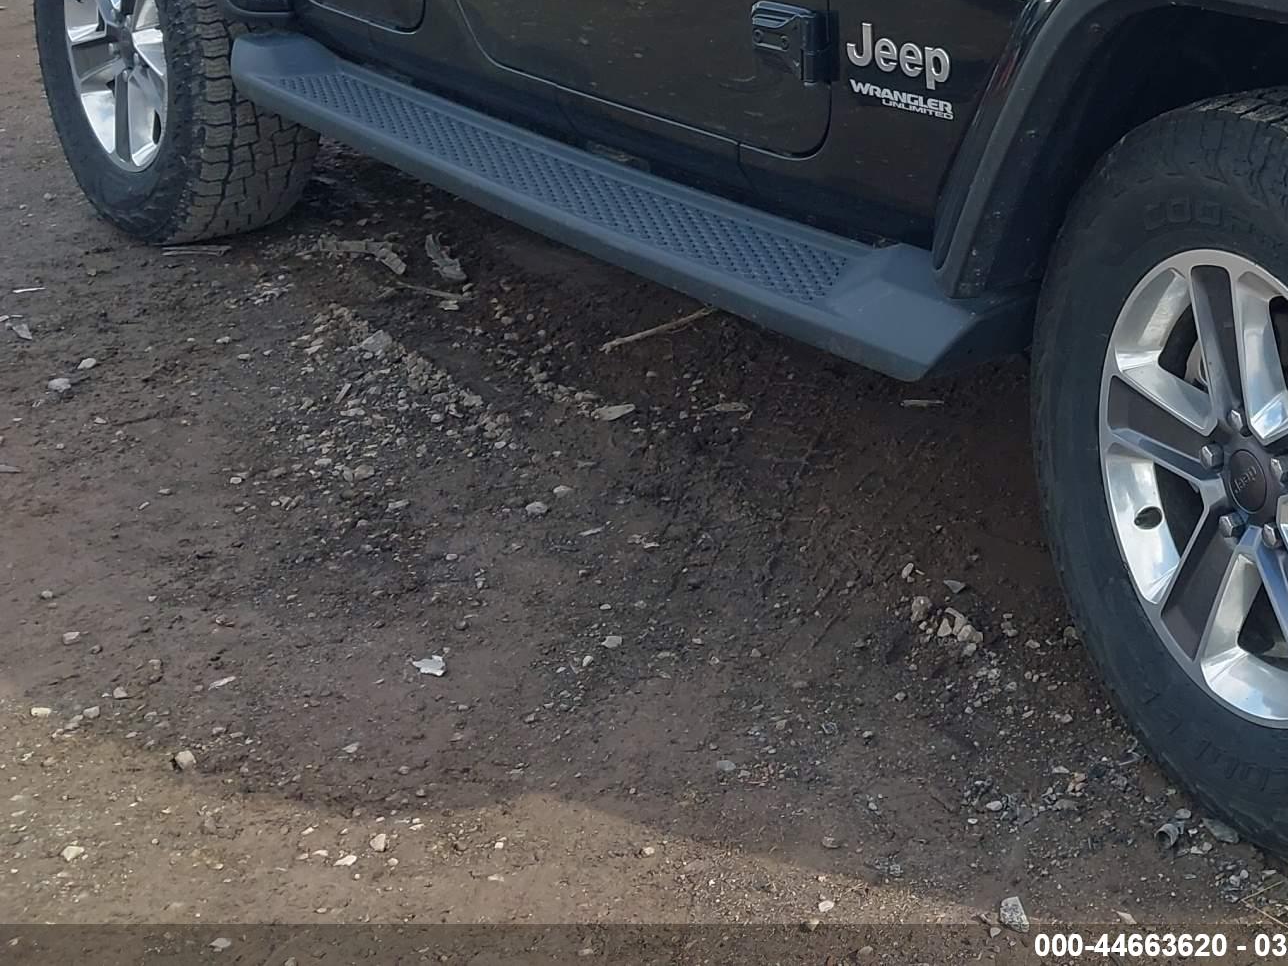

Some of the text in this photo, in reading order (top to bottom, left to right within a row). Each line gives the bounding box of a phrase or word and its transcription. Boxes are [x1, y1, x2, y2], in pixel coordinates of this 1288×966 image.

[846, 22, 950, 90] Jeep
[849, 79, 953, 114] WRANGLER
[881, 98, 954, 120] UNLIMITED
